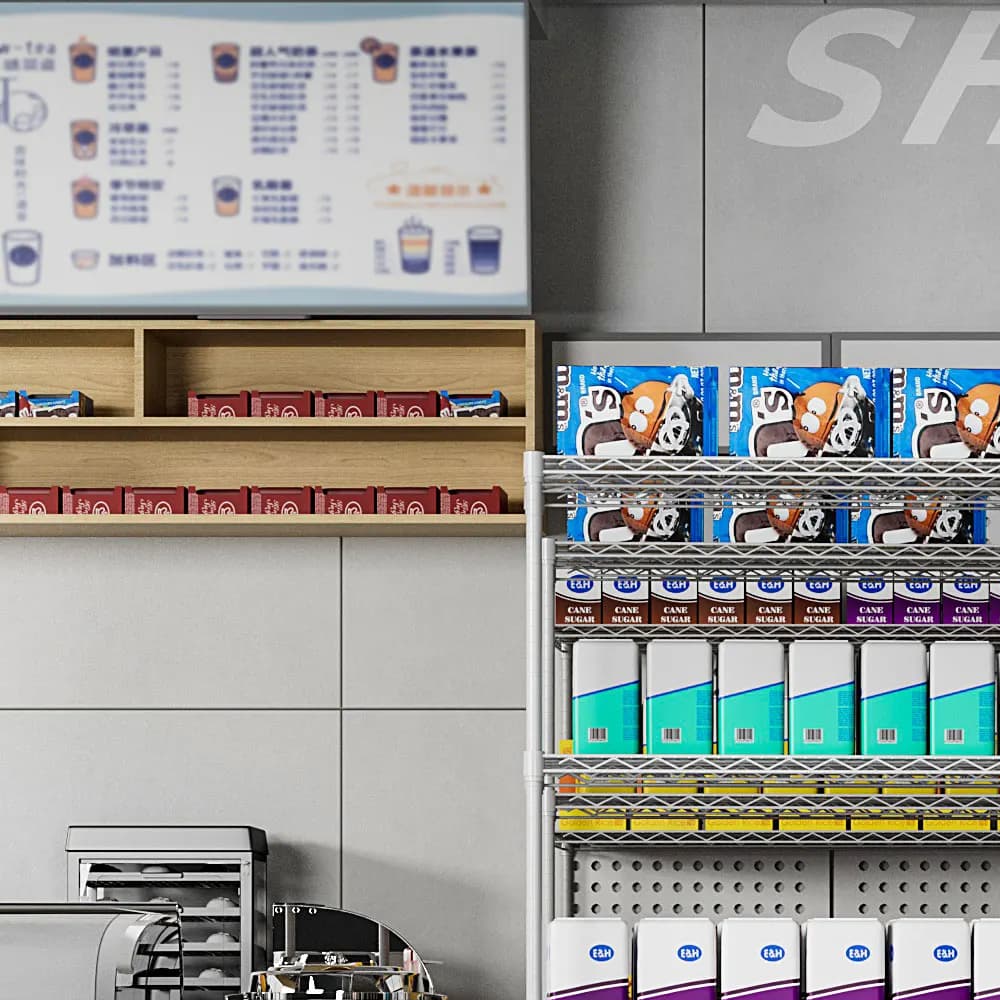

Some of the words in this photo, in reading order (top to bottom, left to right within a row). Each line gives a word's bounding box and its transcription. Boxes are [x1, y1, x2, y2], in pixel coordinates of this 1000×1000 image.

[567, 606, 592, 614] CANE
[807, 606, 831, 614] CANE
[859, 606, 883, 614] CANE
[564, 616, 595, 624] SUGAR
[803, 616, 834, 624] SUGAR
[856, 616, 887, 624] SUGAR
